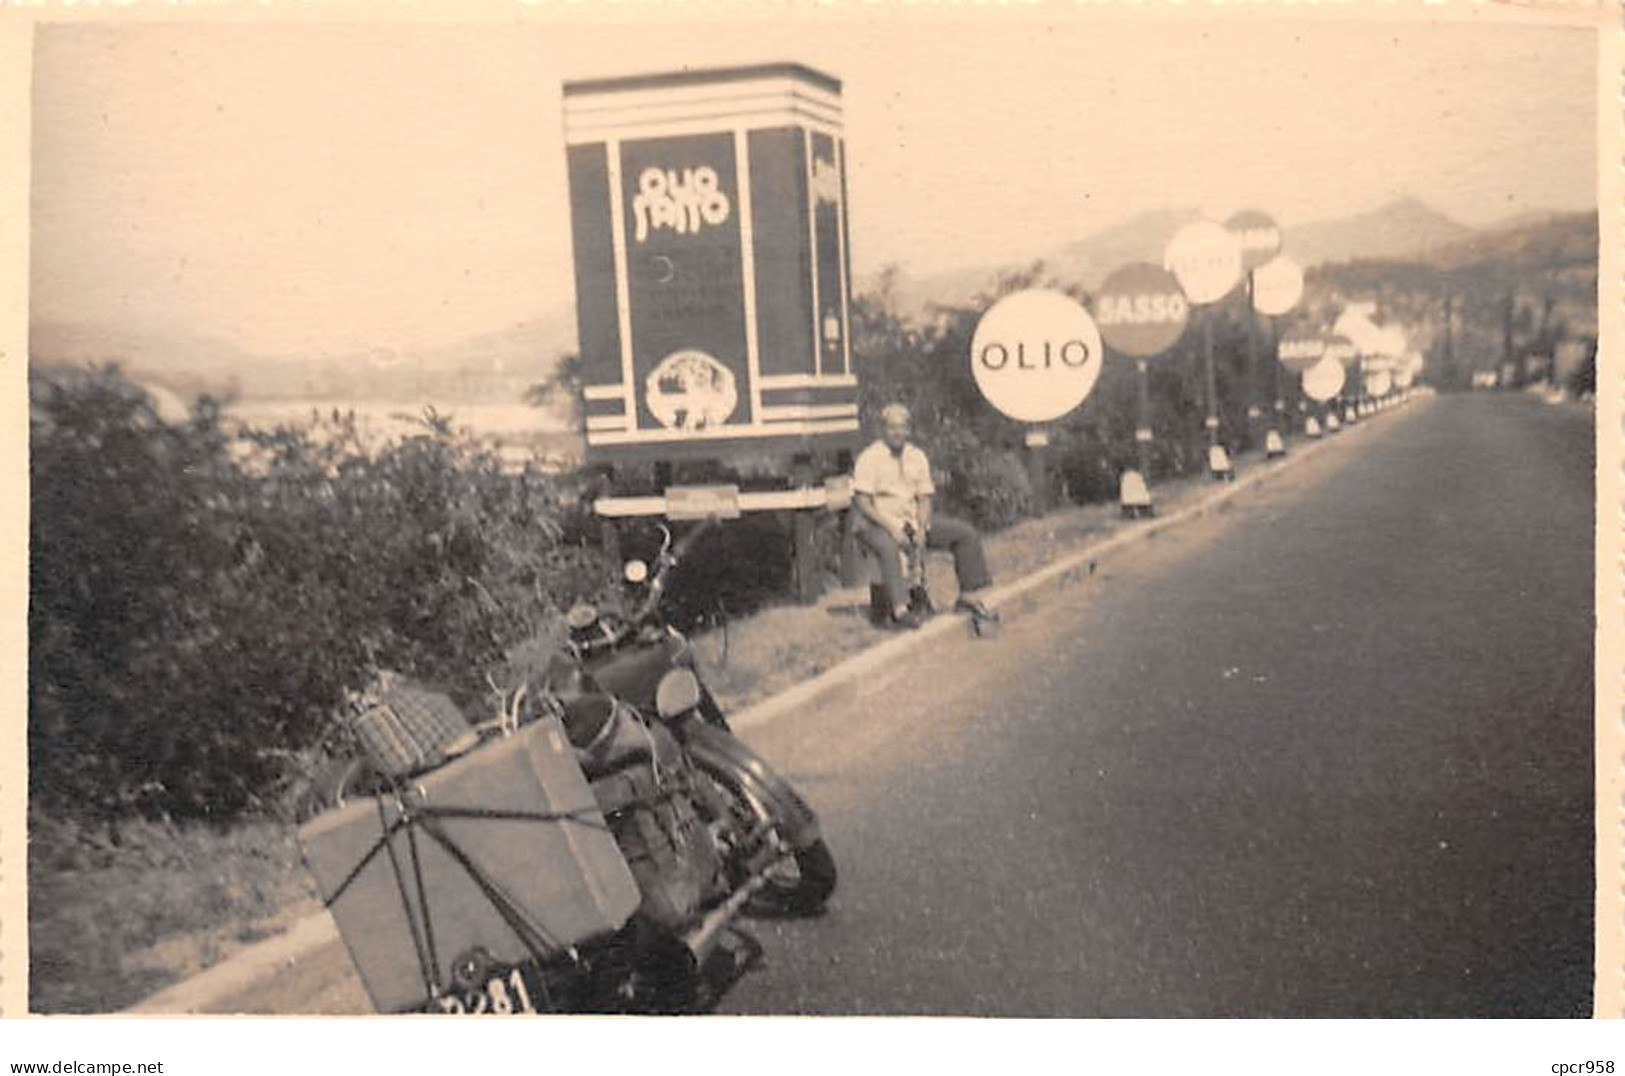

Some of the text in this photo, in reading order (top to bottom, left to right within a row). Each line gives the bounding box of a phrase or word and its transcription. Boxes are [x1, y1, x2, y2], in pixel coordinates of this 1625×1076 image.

[639, 167, 719, 201] OLIO
[1098, 293, 1187, 324] SASSO
[981, 340, 1089, 370] OLIO
